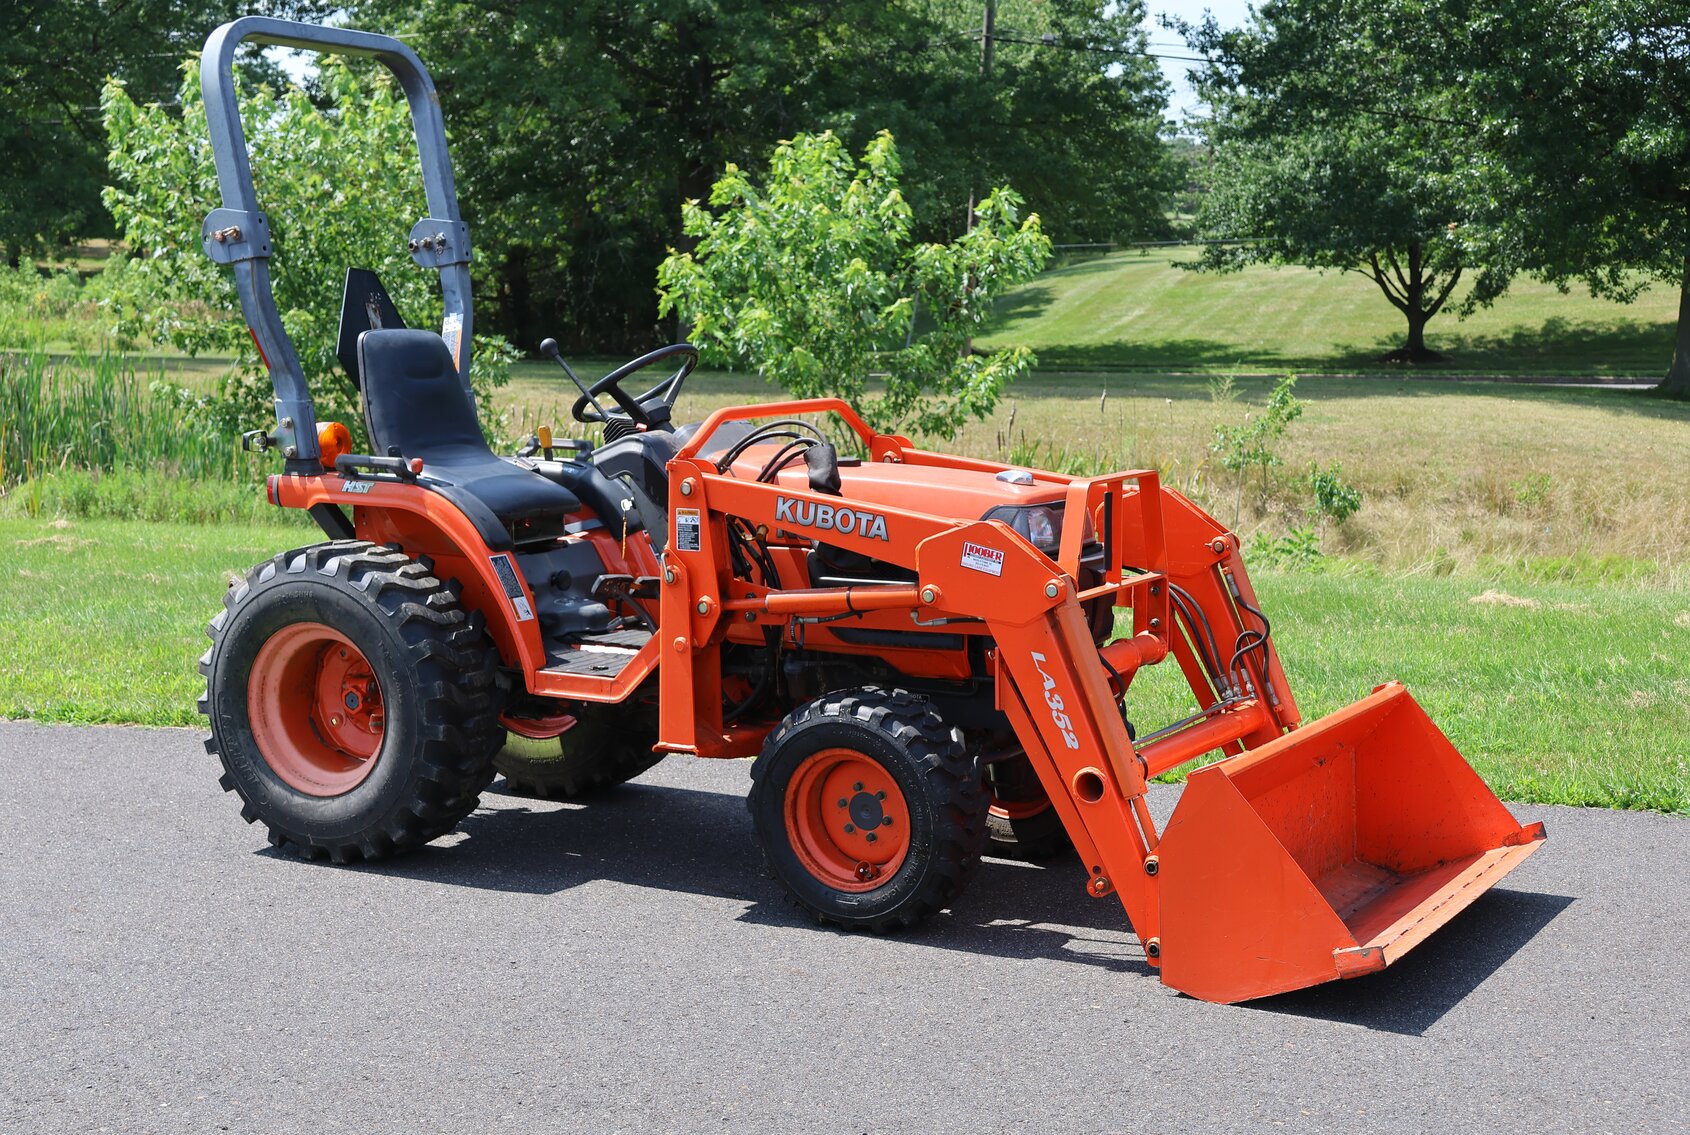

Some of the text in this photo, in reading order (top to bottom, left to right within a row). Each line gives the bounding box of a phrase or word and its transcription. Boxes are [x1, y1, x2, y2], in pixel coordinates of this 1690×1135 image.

[342, 480, 375, 494] HST
[775, 496, 889, 542] KUBOTA
[1031, 651, 1080, 750] LA352
